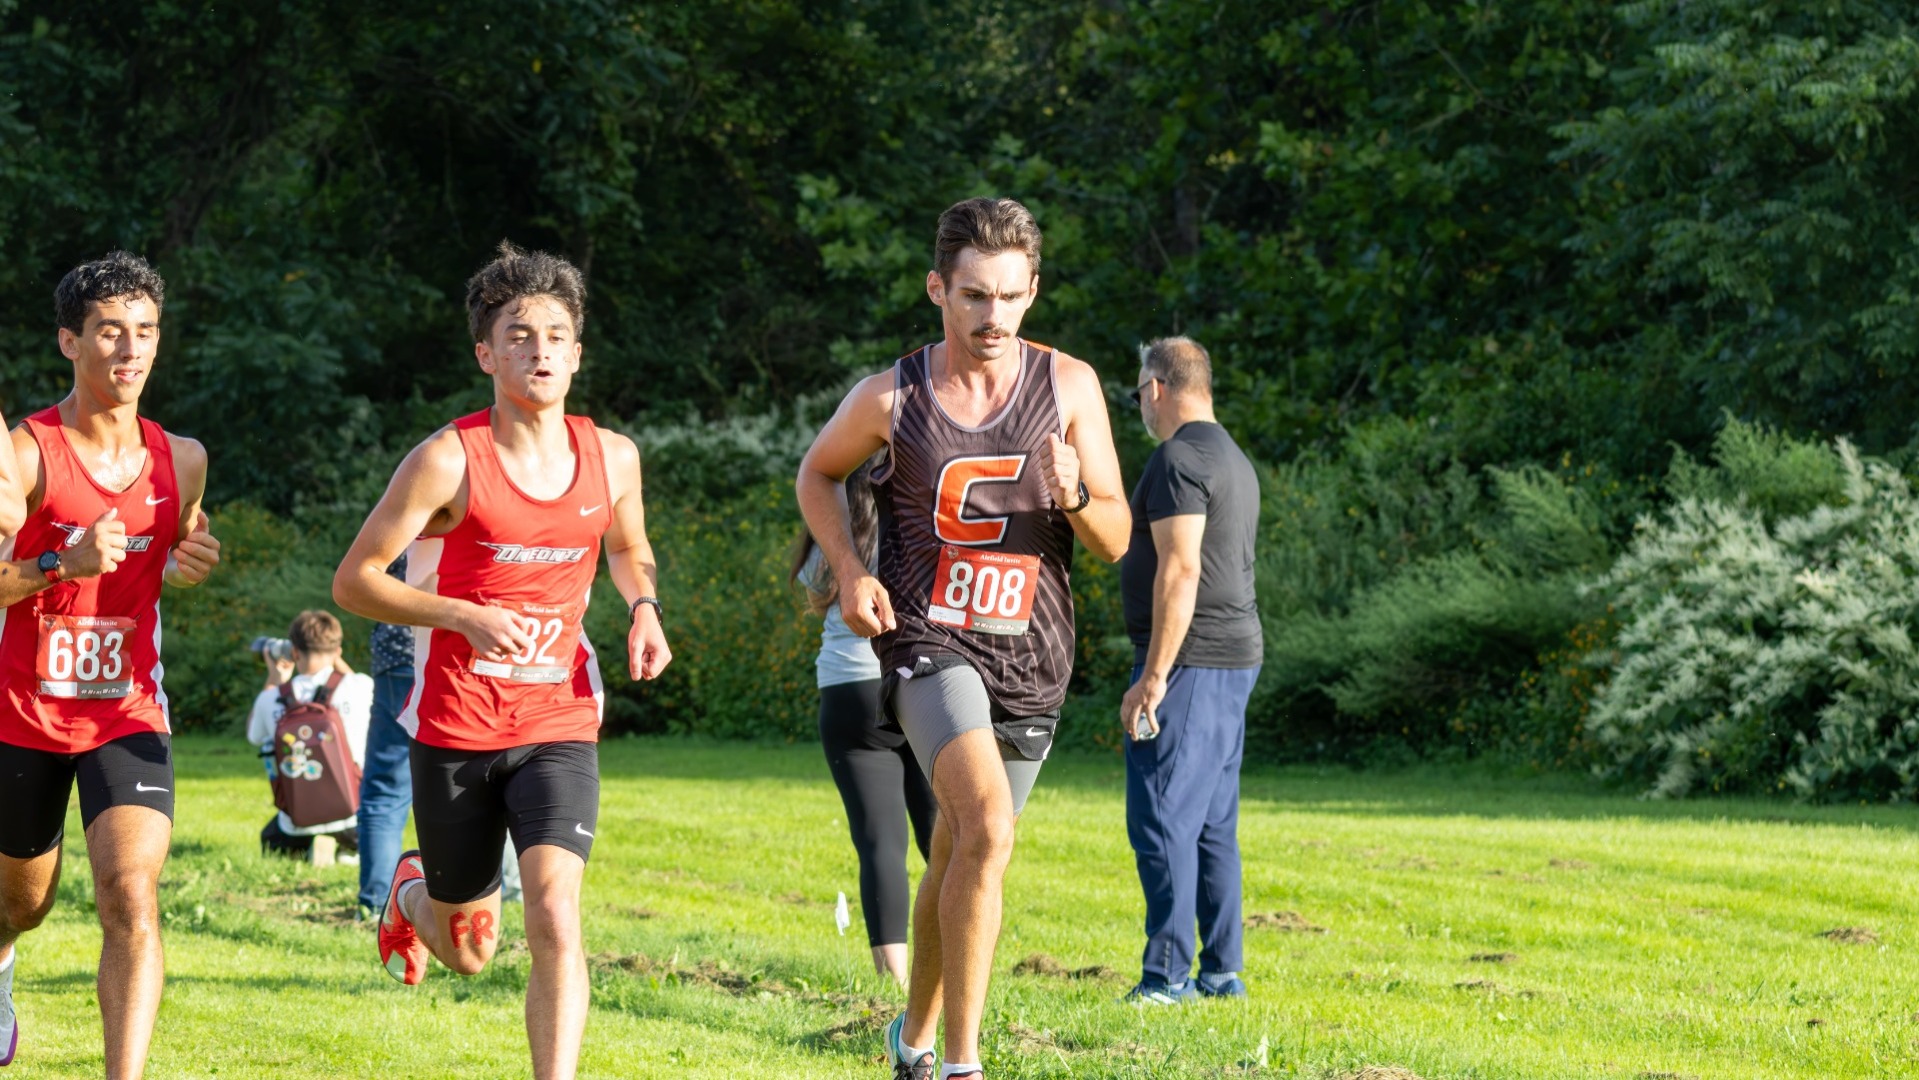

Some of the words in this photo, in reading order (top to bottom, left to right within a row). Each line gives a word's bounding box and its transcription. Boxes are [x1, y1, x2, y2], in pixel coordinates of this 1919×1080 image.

[933, 453, 1028, 545] C
[980, 554, 1003, 563] Airfield
[945, 561, 1026, 617] 808
[48, 629, 124, 680] 683
[449, 910, 494, 949] FR
